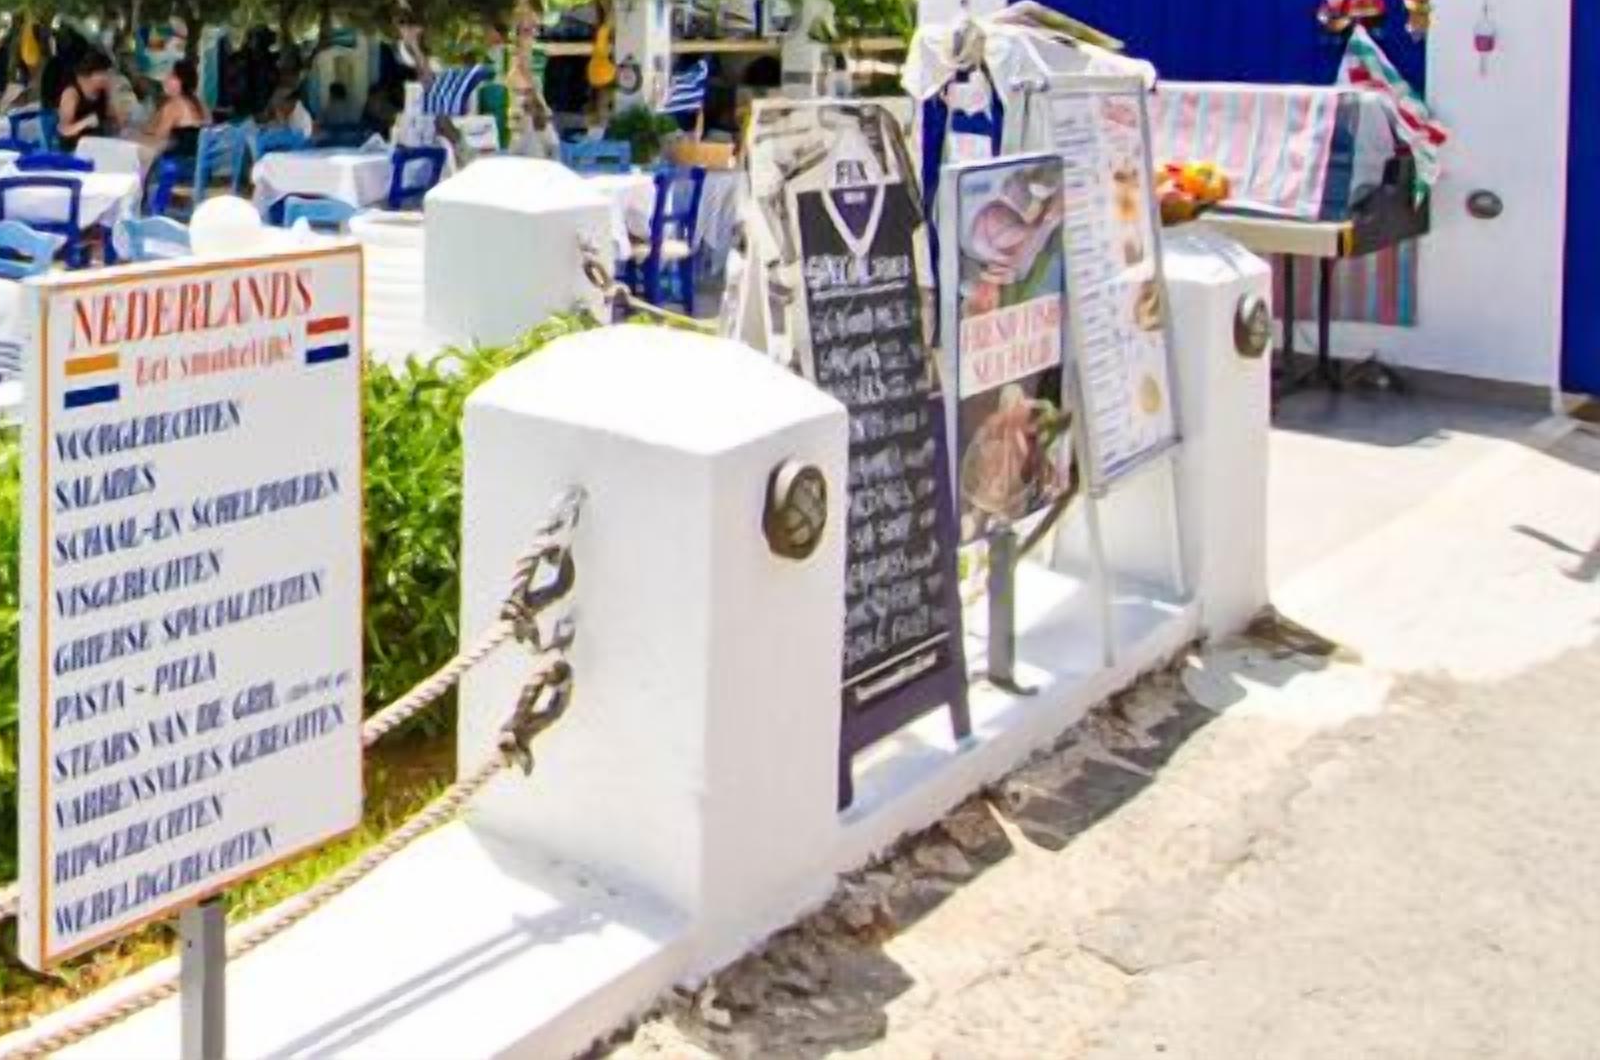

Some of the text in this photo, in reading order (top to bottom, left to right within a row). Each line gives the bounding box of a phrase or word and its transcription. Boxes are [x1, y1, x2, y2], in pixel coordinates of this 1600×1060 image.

[70, 268, 313, 350] NEDERLANDS
[56, 399, 242, 461] VOORGERECHTEN
[56, 548, 223, 618] VISGERECHTEN
[55, 678, 125, 728] PASTA
[154, 650, 216, 696] PIZZA
[149, 710, 188, 747] VAN
[196, 700, 225, 734] DE
